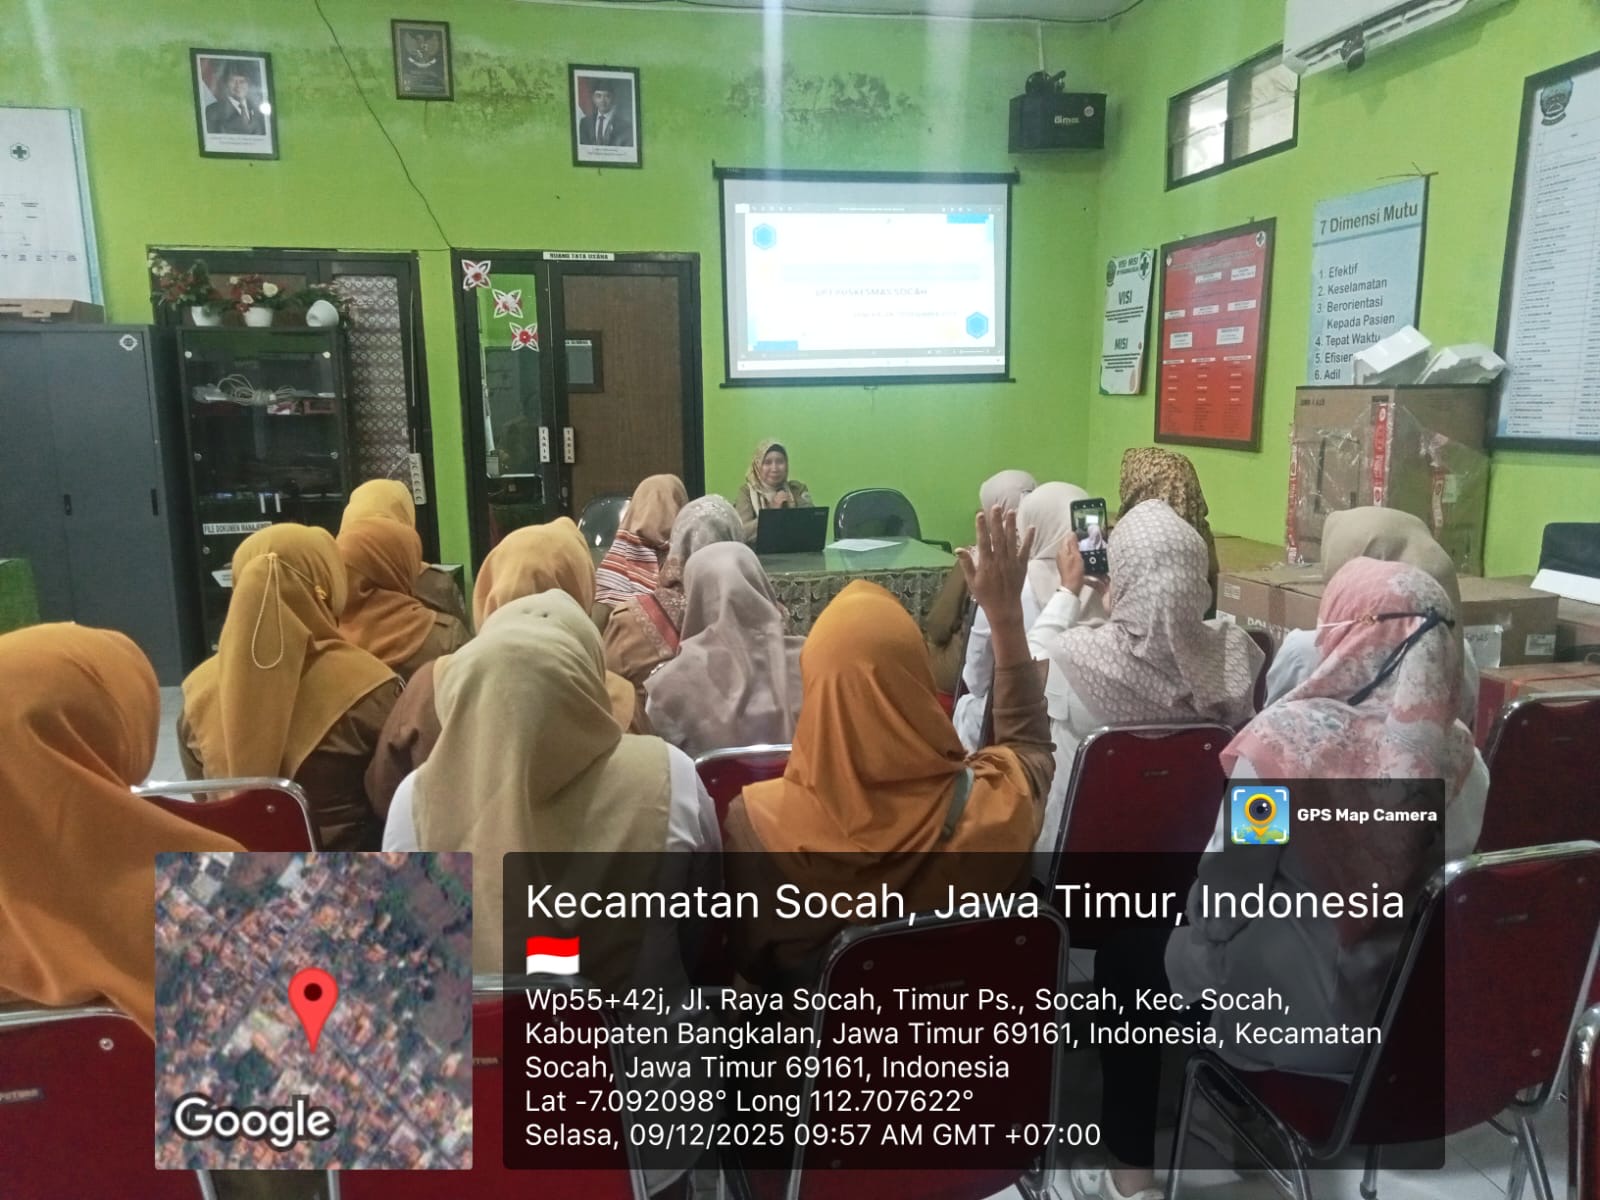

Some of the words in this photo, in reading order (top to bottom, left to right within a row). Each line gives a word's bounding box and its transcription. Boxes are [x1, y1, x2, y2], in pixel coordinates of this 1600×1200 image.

[1320, 220, 1327, 236] 7
[1330, 208, 1380, 233] Dimensi
[1383, 203, 1418, 222] Mutu
[1328, 263, 1359, 278] Efektif
[1327, 278, 1388, 296] Keselamatan
[1118, 290, 1132, 306] VISI
[1326, 296, 1384, 313] Berorientasi
[1326, 316, 1361, 331] Kepada
[1363, 314, 1395, 327] Pasien
[1315, 336, 1323, 347] 4.
[1325, 335, 1350, 348] Tepat
[1351, 331, 1381, 345] Waktu
[1315, 352, 1322, 364] 5.
[1314, 369, 1322, 380] 6.
[1324, 369, 1341, 380] Adil
